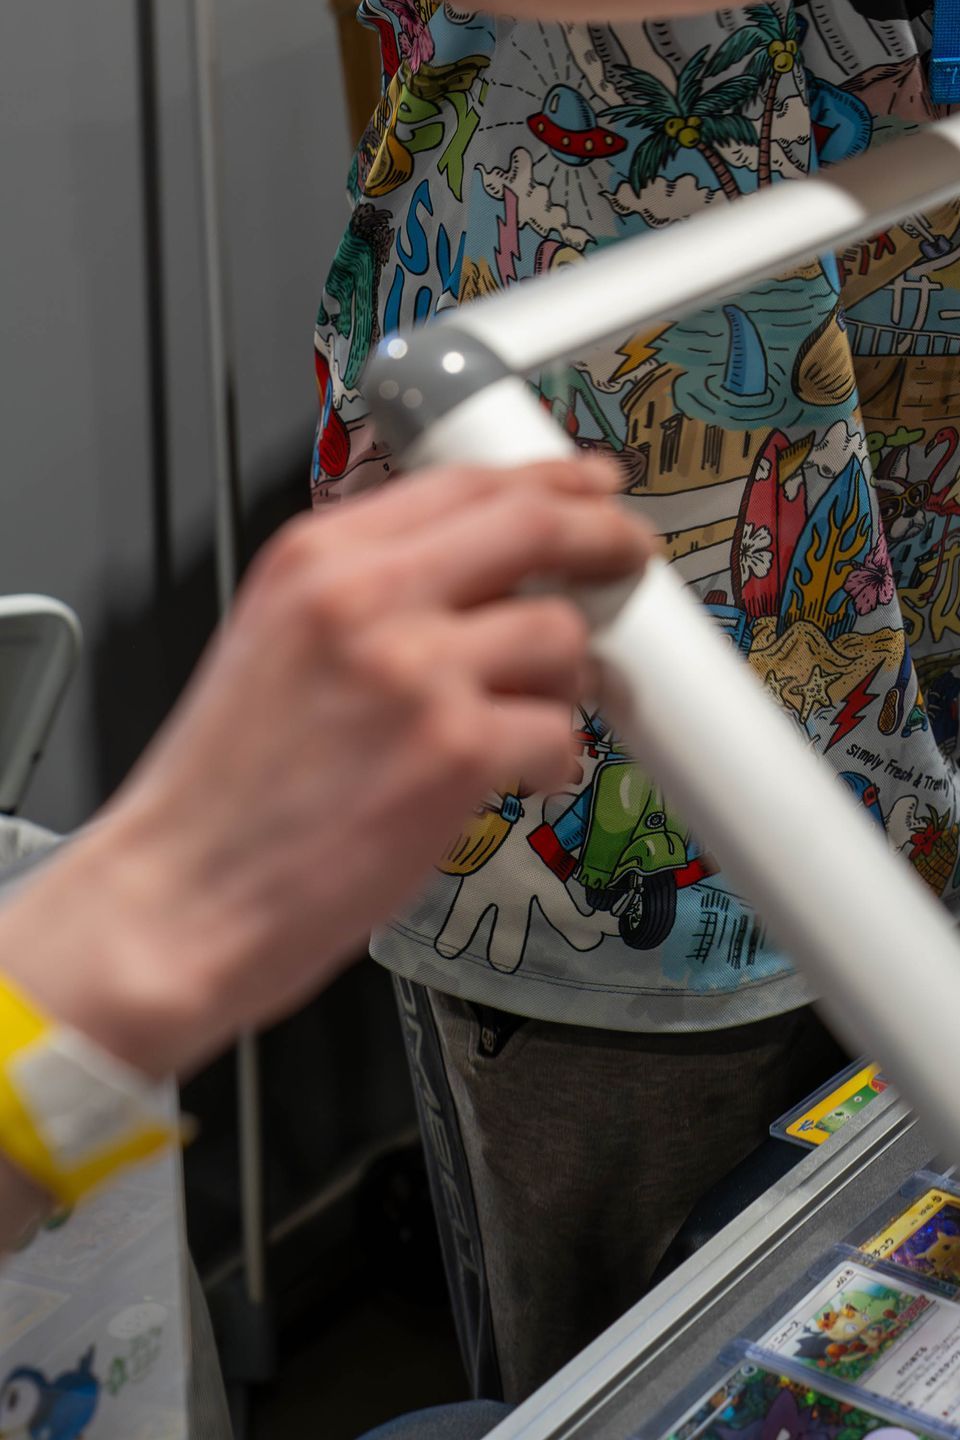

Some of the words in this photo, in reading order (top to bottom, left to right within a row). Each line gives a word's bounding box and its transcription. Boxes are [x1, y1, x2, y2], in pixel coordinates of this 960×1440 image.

[846, 744, 883, 771] Simply
[885, 759, 913, 782] Fresh
[913, 773, 923, 789] &
